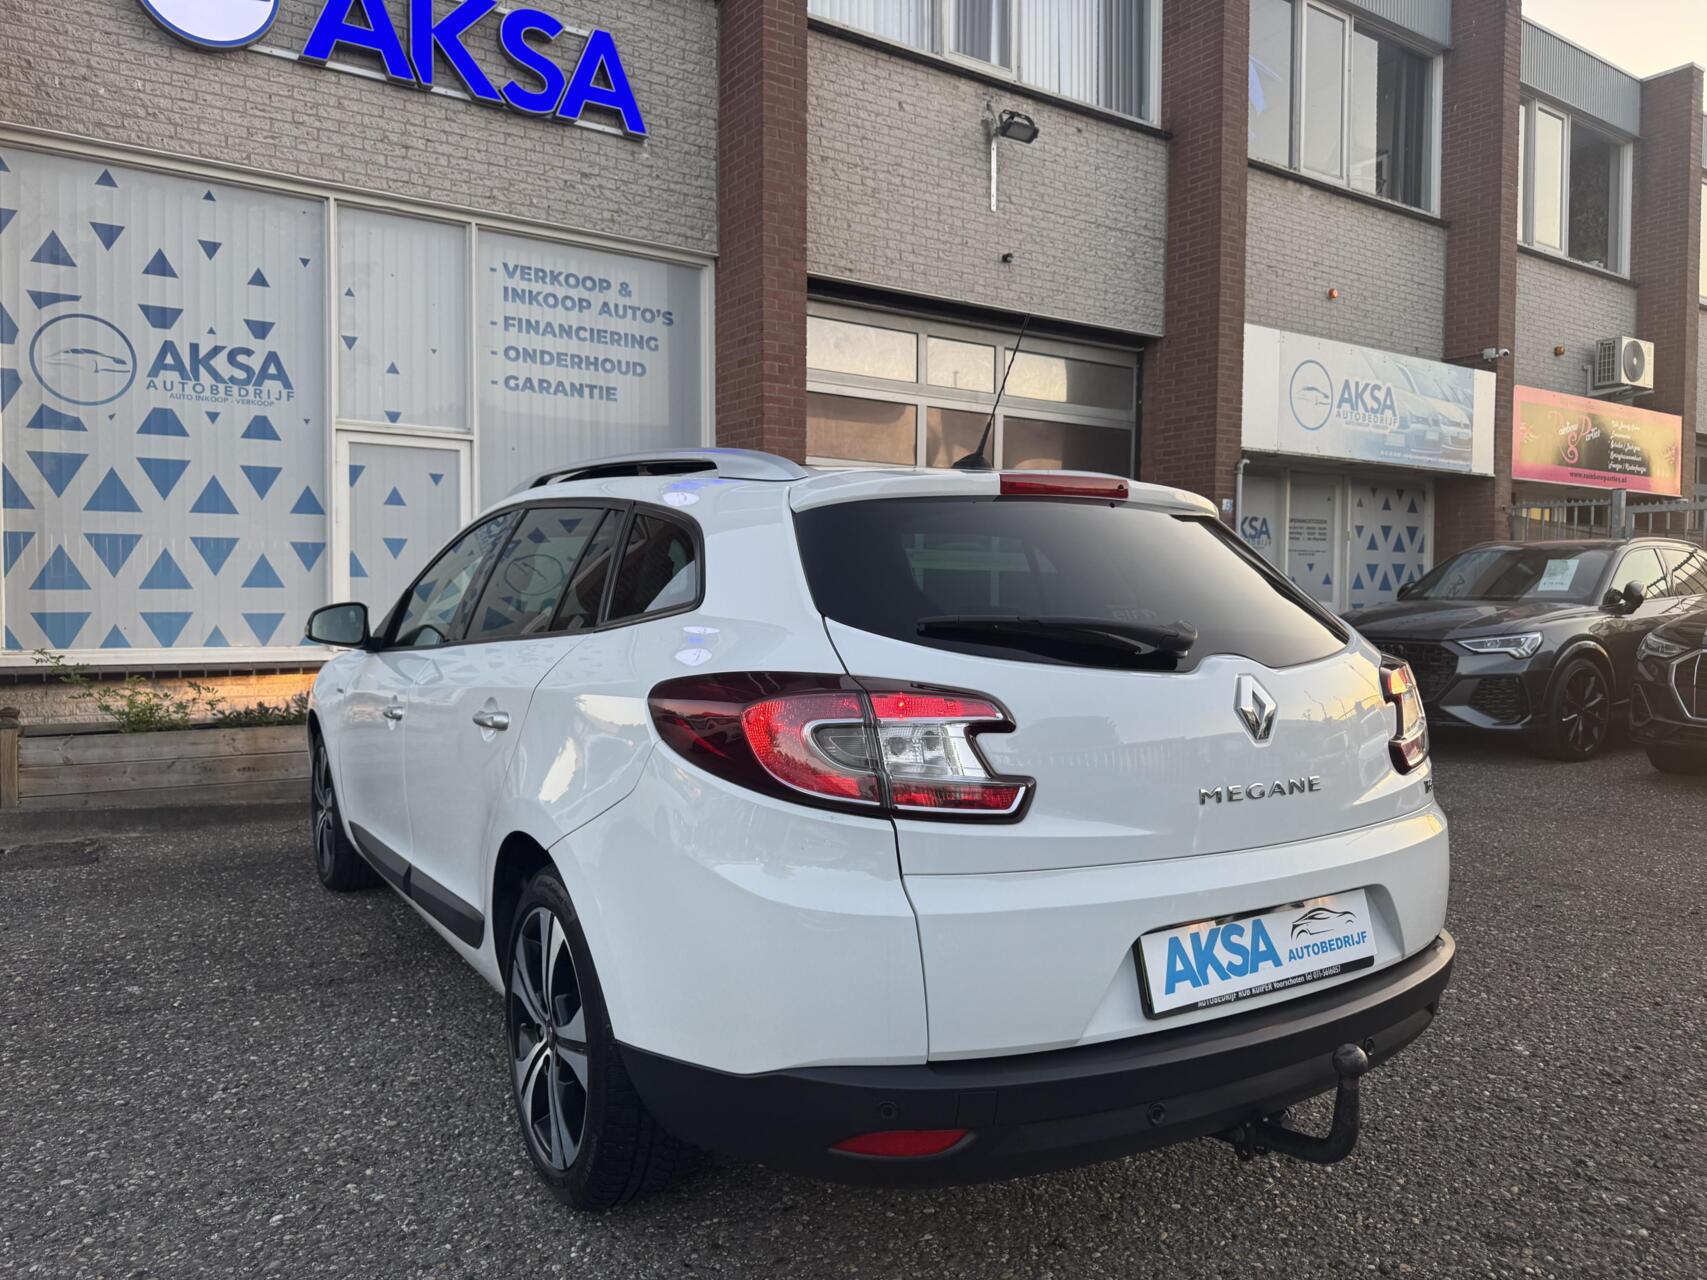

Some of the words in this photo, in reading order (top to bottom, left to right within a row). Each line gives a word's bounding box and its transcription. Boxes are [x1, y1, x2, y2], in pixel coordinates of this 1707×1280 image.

[300, 0, 648, 141] AKSA
[502, 262, 612, 293] VERKOOP
[618, 281, 632, 298] &
[503, 286, 592, 313] INKOOP
[598, 301, 674, 327] AUTO'S
[503, 315, 660, 351] FINANCIERING
[146, 339, 294, 390] AKSA
[503, 345, 647, 377] ONDERHOUD
[146, 379, 295, 401] AUTOBEDRIJF
[169, 392, 193, 401] AUTO
[195, 395, 229, 404] INKOOP
[235, 399, 275, 408] VERKOOP
[503, 375, 618, 401] GARANTIE
[1336, 379, 1397, 417] AKSA
[1335, 410, 1399, 427] AUTOBEDRIJF
[1199, 775, 1322, 805] MEGANE
[1164, 918, 1282, 996] AKSA
[1287, 930, 1368, 962] AUTOBEDRIJF
